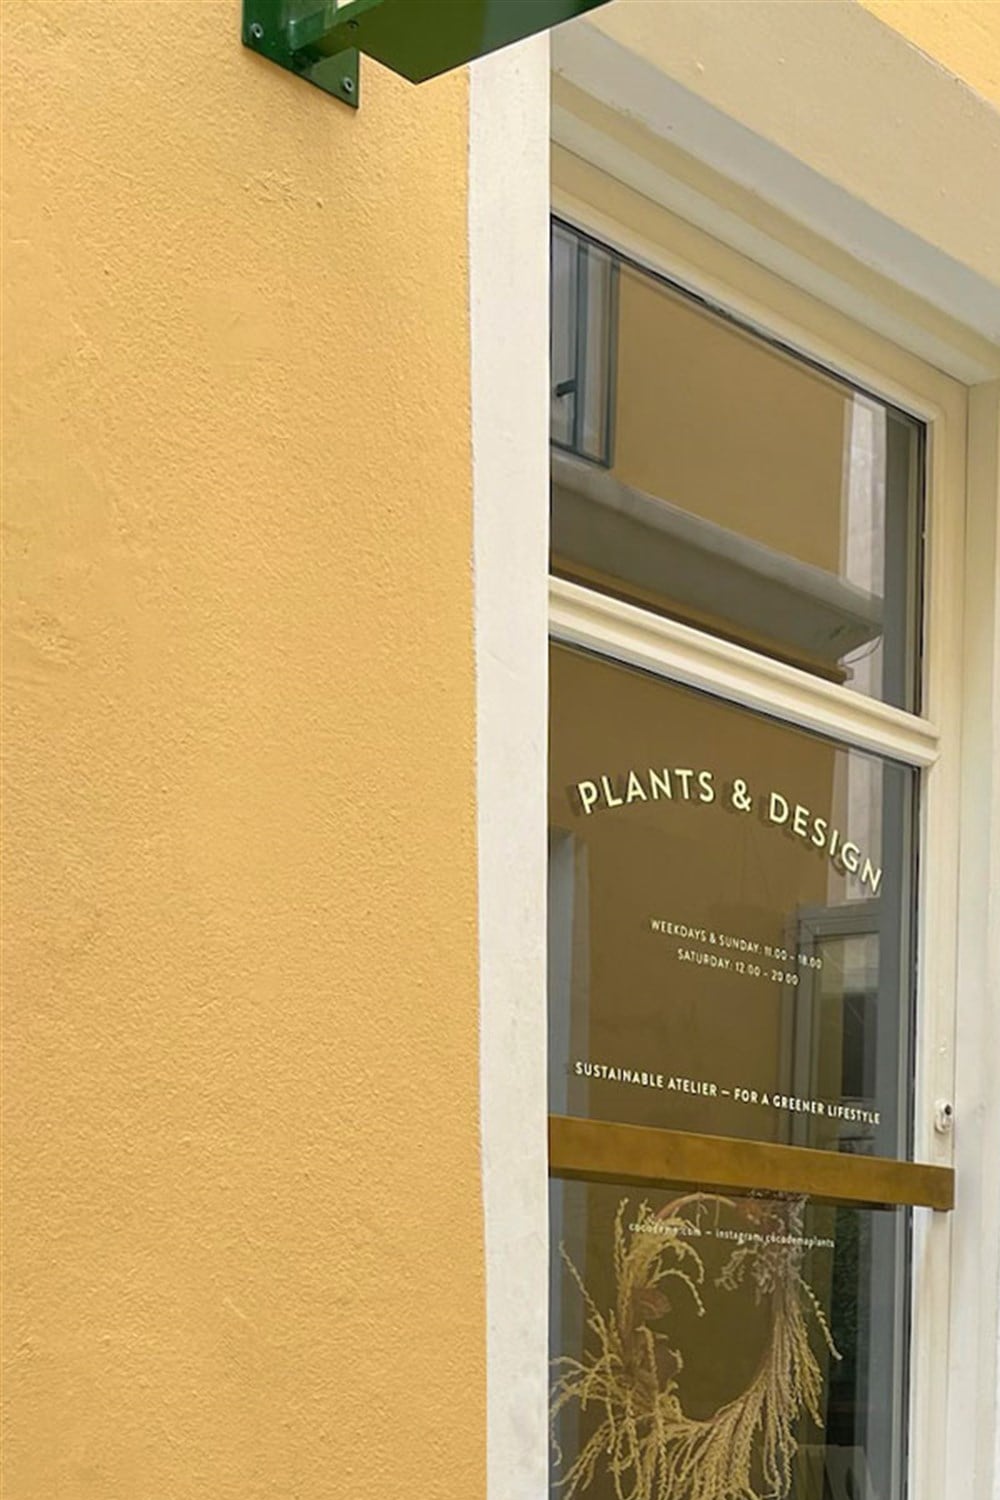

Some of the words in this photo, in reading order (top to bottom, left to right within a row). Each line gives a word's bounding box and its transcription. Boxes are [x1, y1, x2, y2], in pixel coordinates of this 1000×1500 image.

[578, 768, 715, 814] PLANTS
[732, 778, 752, 812] &
[769, 792, 883, 894] DESIGN
[651, 919, 707, 942] WEEKDAYS
[709, 932, 717, 944] &
[735, 961, 761, 977] 1200
[771, 969, 799, 986] 2000
[575, 1061, 664, 1088] SUSTAINABLE
[667, 1077, 717, 1097] ATELIER
[734, 1088, 759, 1104] FOR
[761, 1093, 770, 1106] A
[773, 1095, 825, 1115] GREENER
[827, 1105, 881, 1125] LIFESTYLE
